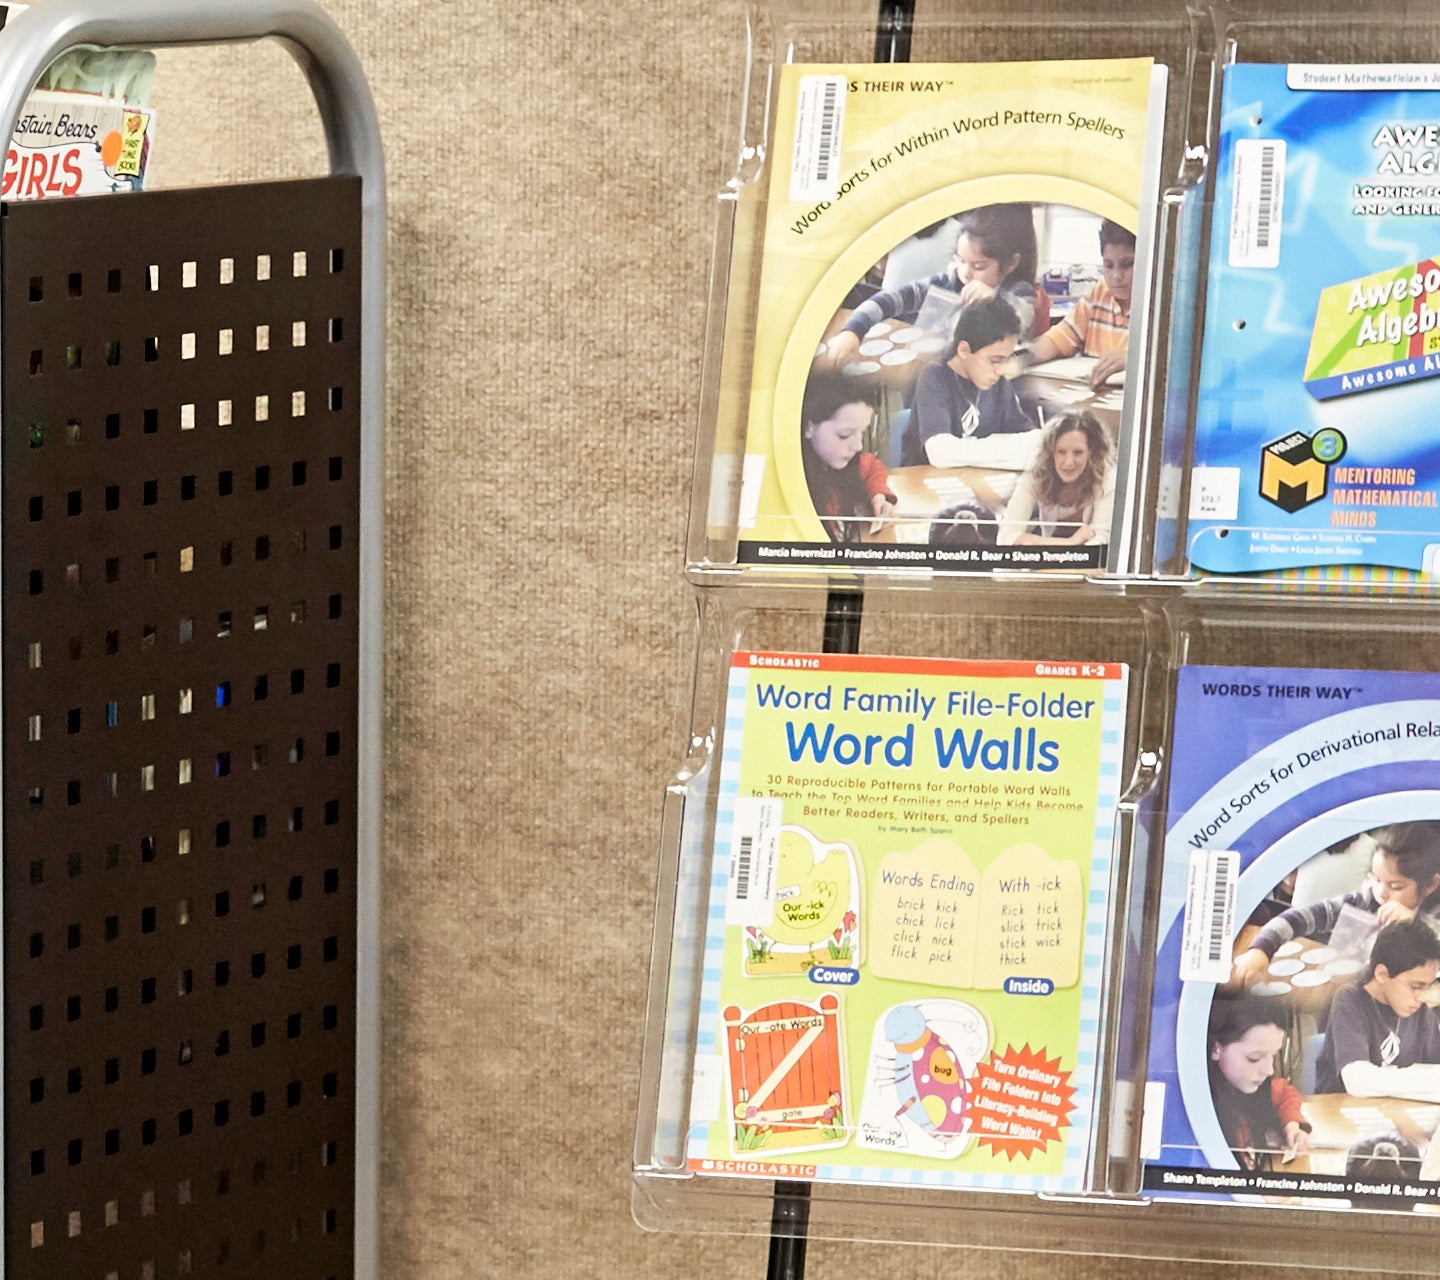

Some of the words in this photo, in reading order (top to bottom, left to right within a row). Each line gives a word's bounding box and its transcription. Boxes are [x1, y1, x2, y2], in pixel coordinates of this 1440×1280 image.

[864, 81, 904, 92] THEIR
[54, 113, 98, 139] Bears
[870, 153, 893, 173] for
[895, 127, 950, 158] Within
[953, 111, 999, 134] Word
[1004, 110, 1061, 125] Pattern
[1066, 112, 1126, 140] Spellers
[2, 149, 83, 198] GIRLS
[1353, 185, 1421, 199] LOOKING
[1354, 204, 1388, 215] AND
[1341, 363, 1417, 390] Awesome
[1334, 467, 1415, 486] MENTORING
[1332, 488, 1439, 508] MATHEMATICAL
[1331, 510, 1377, 528] MINDS
[749, 655, 820, 668] SCHOLASTIC
[1036, 665, 1077, 676] GRADES
[1082, 665, 1105, 677] K-2
[1203, 683, 1261, 697] WORDS
[1267, 685, 1310, 699] THEIR
[756, 683, 831, 711] Word
[844, 688, 936, 721] Family
[947, 691, 1095, 719] File-Folder
[785, 721, 915, 767] Word
[934, 727, 1060, 772] Walls
[767, 774, 782, 785] 30
[787, 775, 866, 791] Reproducible
[871, 778, 922, 791] Patterns
[926, 781, 943, 792] for
[948, 782, 999, 795] Portable
[1004, 784, 1035, 796] Word
[1039, 785, 1071, 797] Walls
[1188, 809, 1231, 850] Word
[1230, 779, 1270, 814] Sorts
[1270, 762, 1294, 785] for
[1297, 723, 1401, 770] Derivational
[803, 805, 841, 819] Better
[846, 807, 897, 821] Readers,
[902, 810, 950, 823] Writers,
[954, 812, 977, 822] and
[982, 813, 1029, 827] Spellers
[882, 870, 923, 887] Words
[930, 874, 975, 896] Ending
[999, 879, 1030, 893] With
[1036, 876, 1061, 892] -ick
[783, 903, 802, 912] Our
[805, 900, 825, 909] -ick
[897, 896, 925, 911] brick
[936, 900, 959, 913] kick
[1001, 904, 1024, 916] Rick
[1037, 902, 1060, 915] tick
[788, 912, 820, 921] Words
[896, 913, 924, 927] chick
[935, 916, 955, 930] lick
[1001, 919, 1025, 932] slick
[1036, 917, 1062, 931] trick
[893, 930, 922, 943] click
[932, 934, 954, 946] nick
[1000, 935, 1026, 949] stick
[1036, 935, 1061, 947] wick
[891, 946, 917, 959] flick
[929, 950, 953, 965] pick
[1000, 952, 1026, 965] thick
[814, 968, 853, 983] Cover
[1009, 979, 1049, 993] Inside
[741, 1025, 760, 1035] Our
[791, 1017, 822, 1028] Words
[934, 1065, 952, 1076] bug
[993, 1060, 1015, 1074] Turn
[1017, 1065, 1061, 1089] Ordinary
[981, 1078, 1001, 1092] File
[1002, 1082, 1039, 1101] Folders
[1041, 1092, 1061, 1105] Into
[975, 1095, 1058, 1127] Literacy-Building
[981, 1117, 1008, 1132] Word
[865, 1134, 896, 1146] Words
[716, 1161, 815, 1176] SCHOLASTIC
